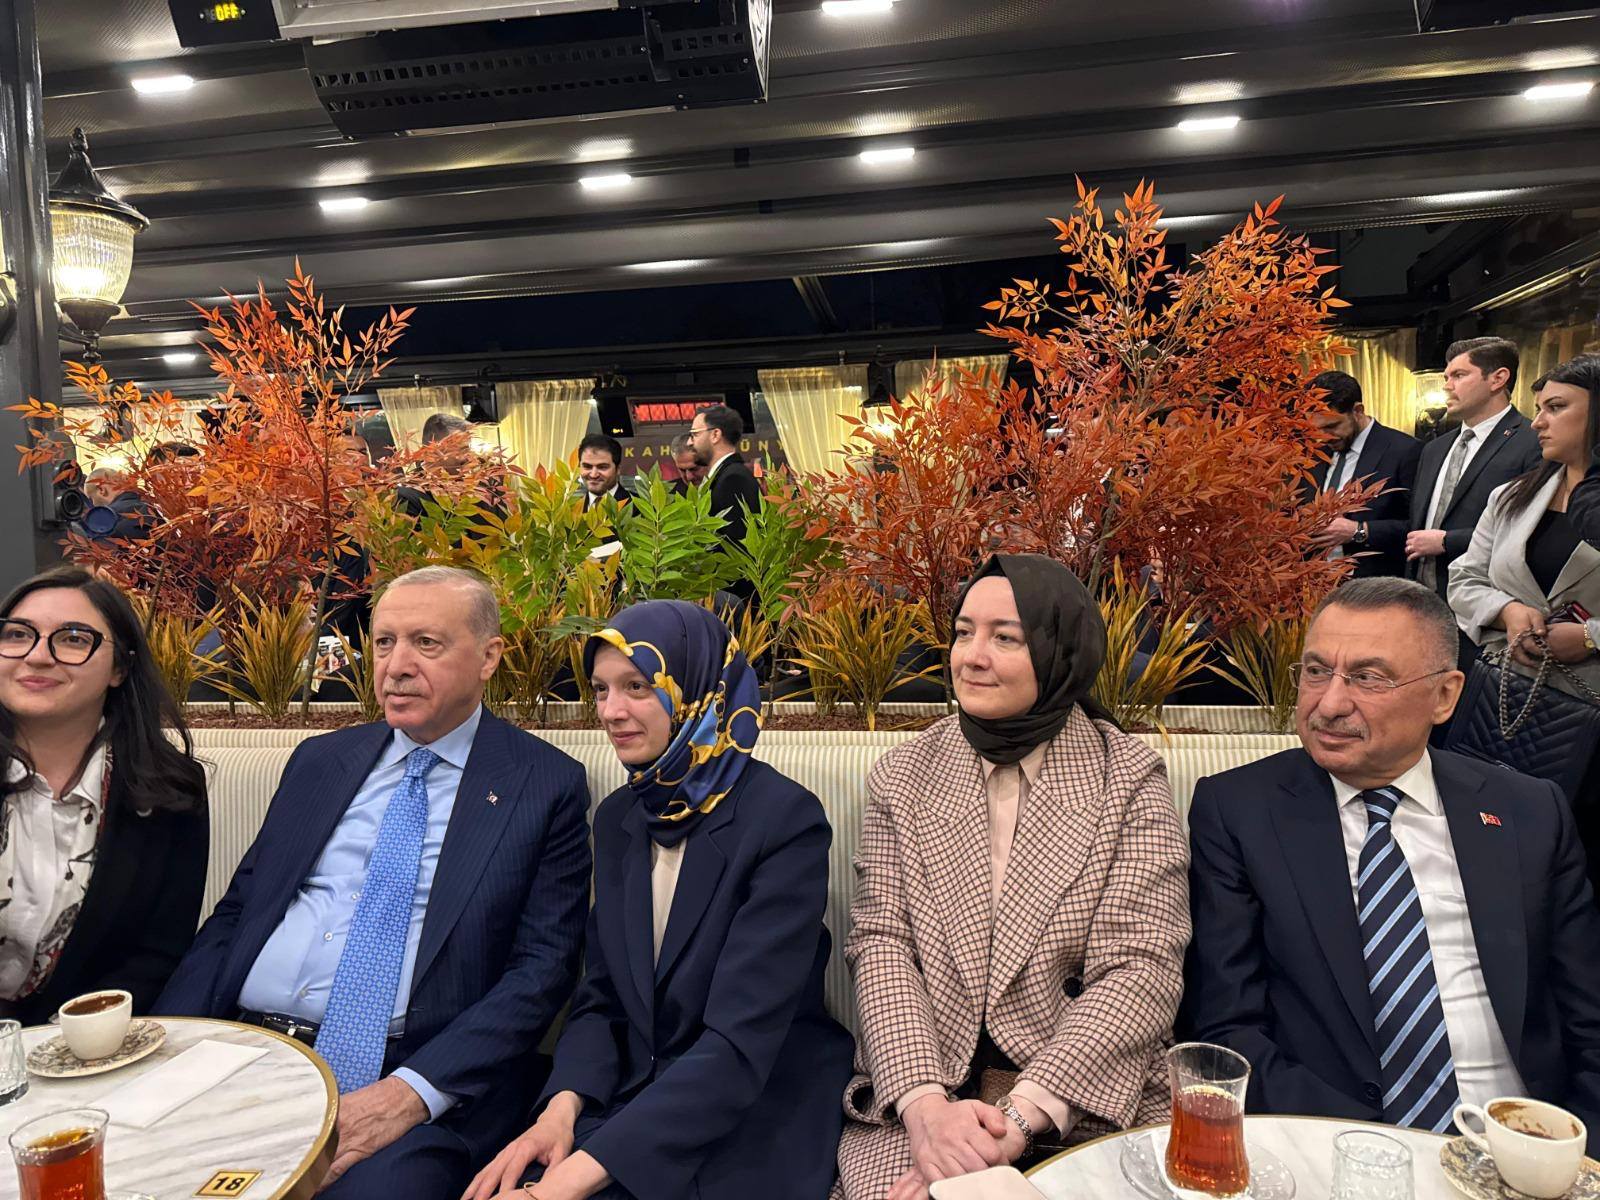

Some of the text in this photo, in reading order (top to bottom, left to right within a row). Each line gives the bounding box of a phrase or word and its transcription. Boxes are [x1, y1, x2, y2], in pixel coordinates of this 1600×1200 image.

[215, 3, 239, 21] OFF
[624, 444, 671, 458] KAH
[212, 1176, 246, 1191] 18
